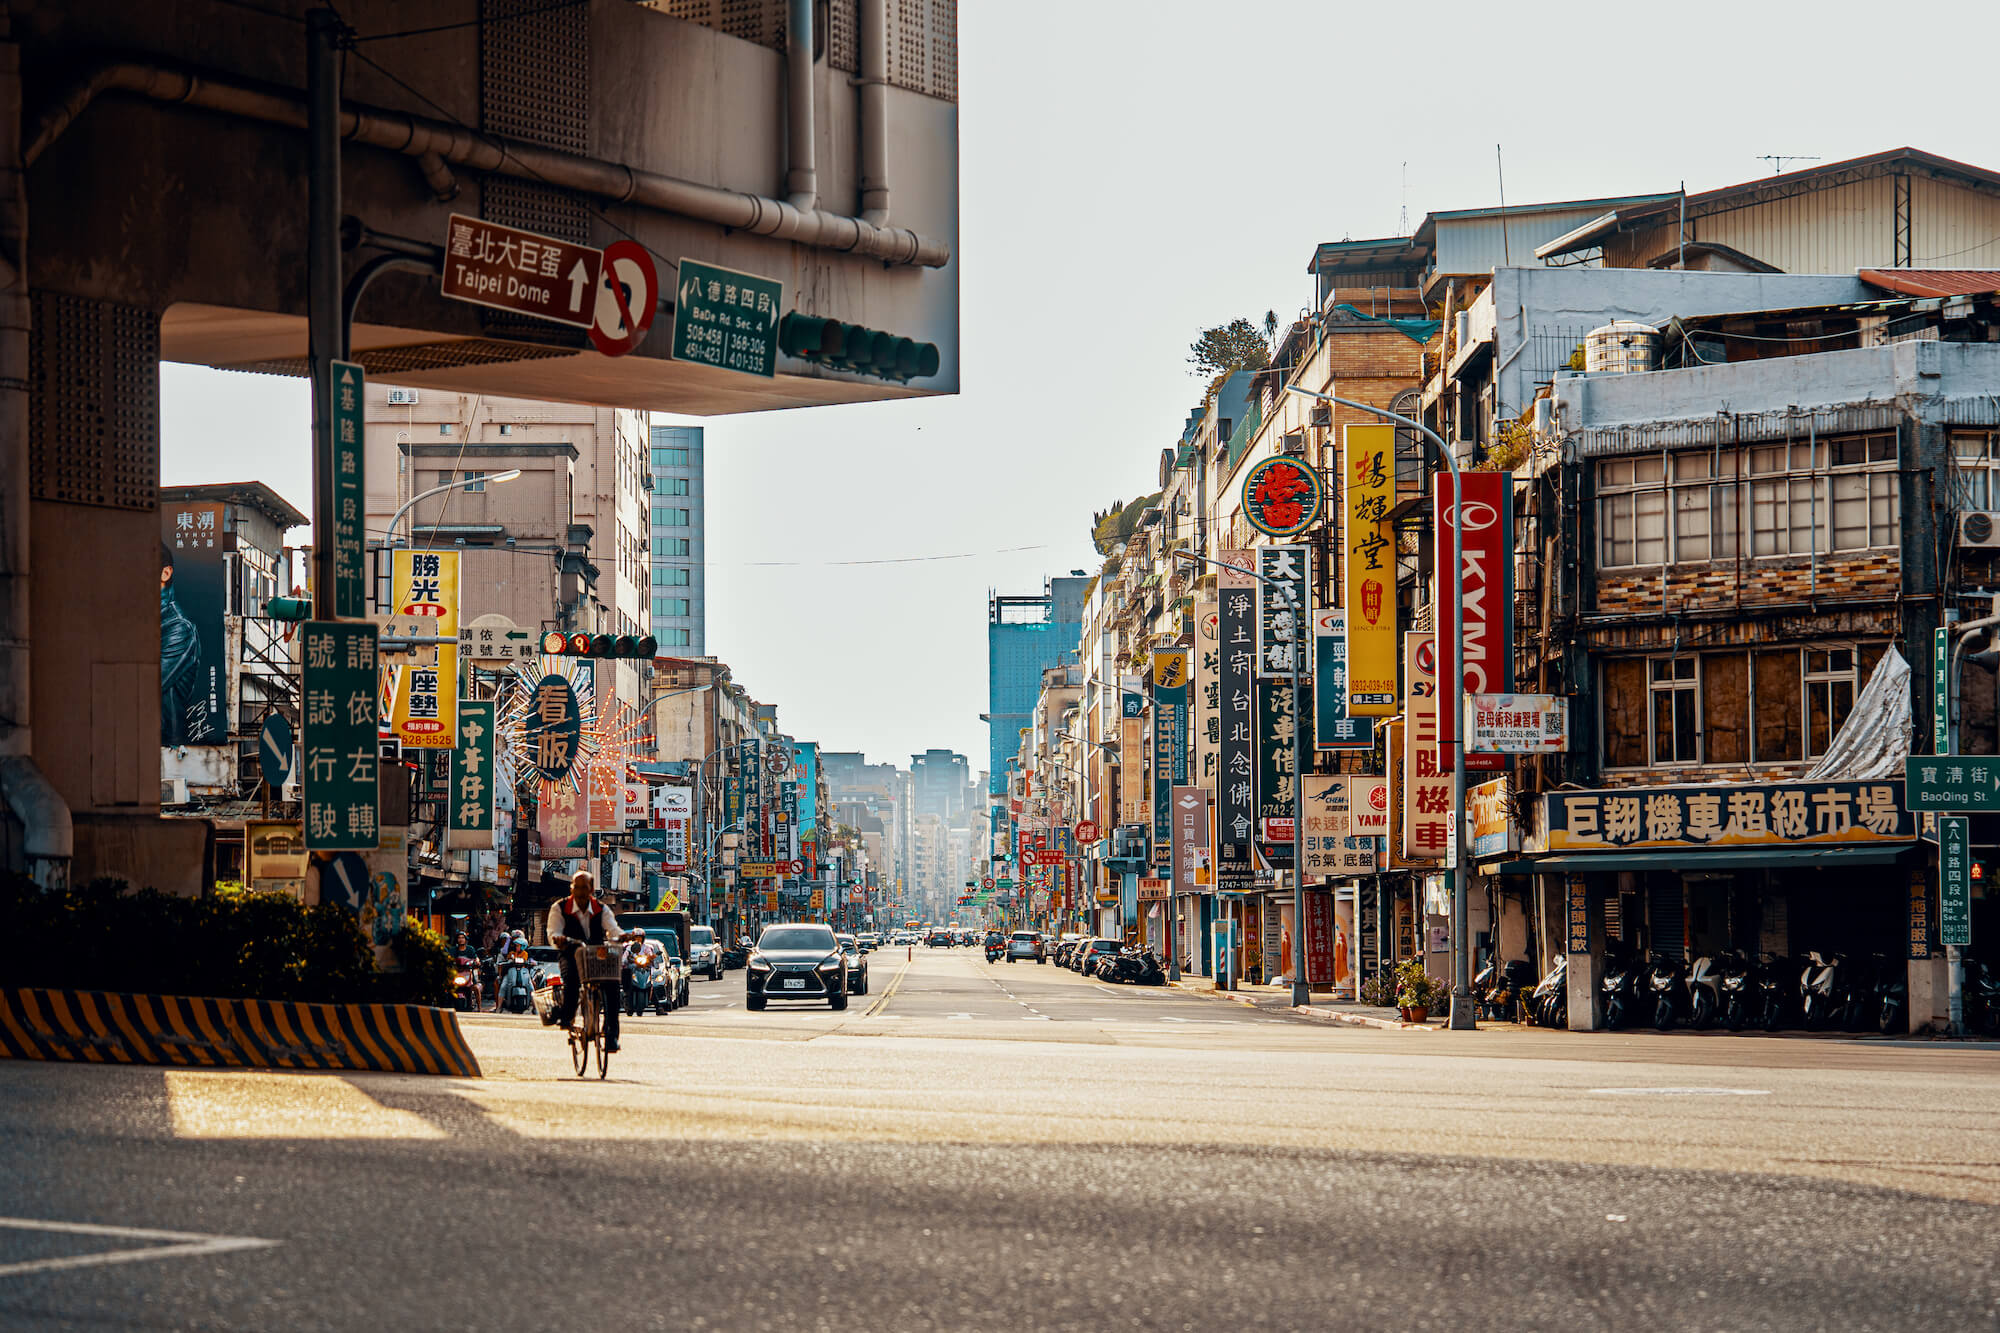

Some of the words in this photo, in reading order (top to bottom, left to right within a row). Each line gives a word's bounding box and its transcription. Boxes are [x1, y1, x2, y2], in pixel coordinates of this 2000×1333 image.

[450, 223, 562, 279] 臺北大巨蛋
[455, 263, 503, 294] Taipei
[506, 275, 550, 305] Dome
[689, 276, 770, 313] 八德路四段
[686, 323, 722, 345] 508-458
[730, 333, 766, 355] 368-306
[692, 306, 716, 322] BaDe
[755, 321, 762, 332] 4
[340, 387, 356, 520] 基隆路一段
[335, 521, 353, 535] Kee
[335, 535, 360, 553] Lung
[411, 554, 440, 602] 勝光
[459, 629, 493, 641] 請依
[459, 644, 533, 657] 燈號左轉
[308, 632, 338, 839] 號誌行駛
[346, 634, 376, 839] 請依左轉
[537, 684, 569, 769] 看板
[1228, 593, 1251, 840] 淨土宗台北念佛會
[1158, 703, 1175, 780] BILSTEIN
[1921, 766, 1989, 785] 寶清街
[1563, 786, 1900, 844] 巨翔機車超級市場
[1921, 791, 1969, 804] BaoQing
[1974, 791, 1989, 802] St.
[1948, 828, 1962, 896] 八德路四段
[1942, 899, 1964, 907] BaDe
